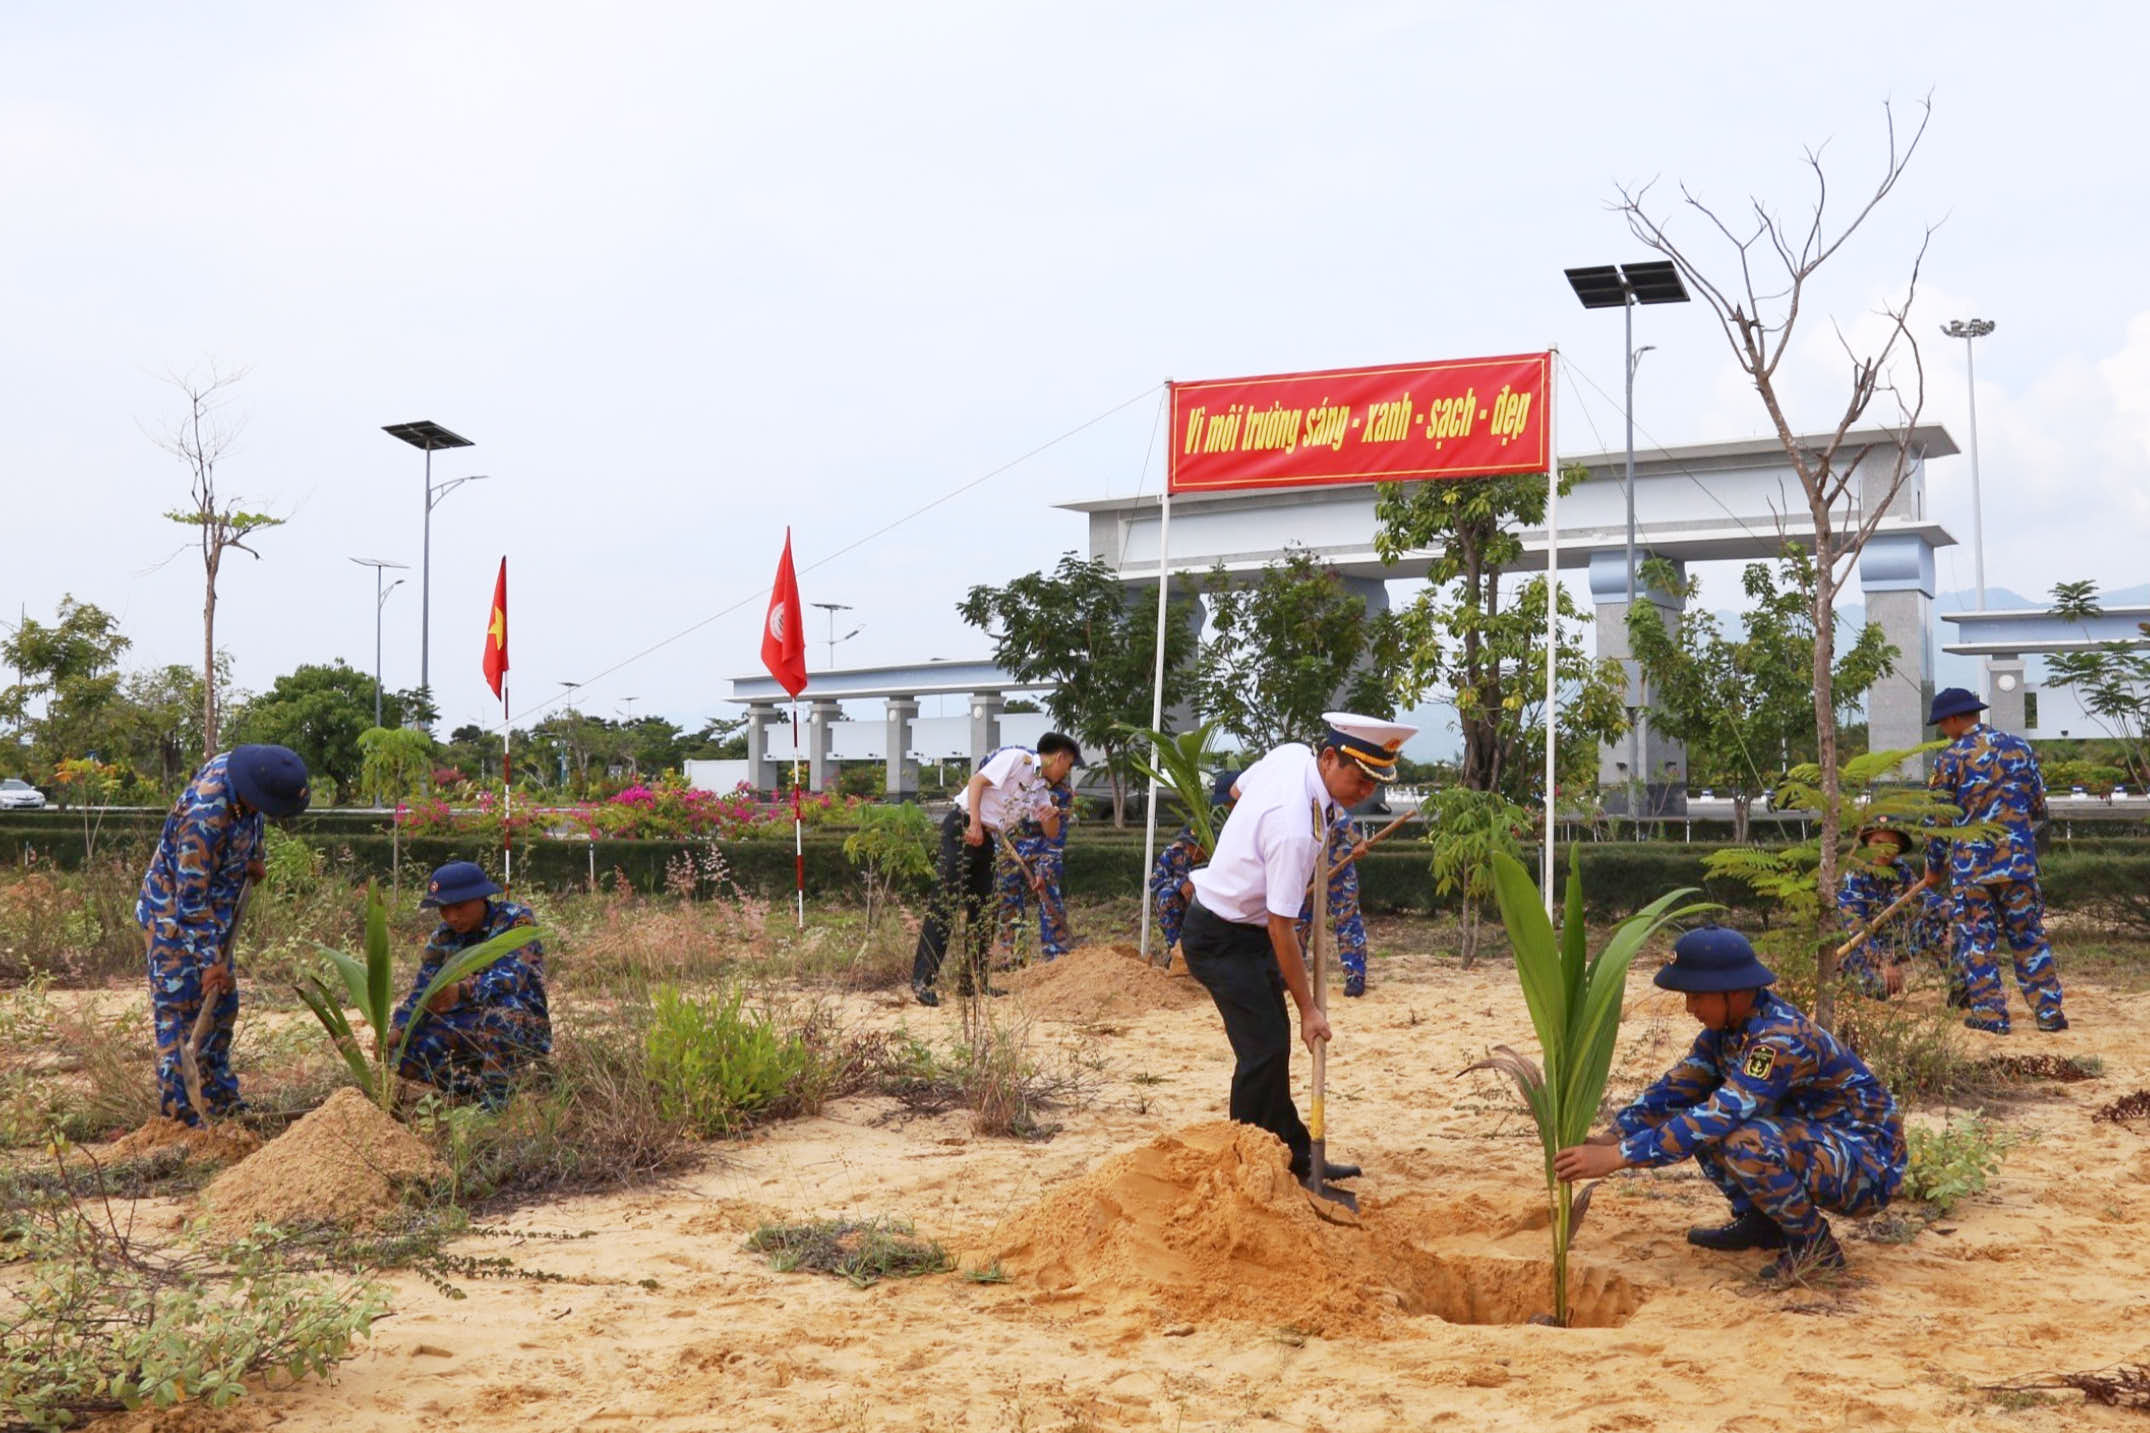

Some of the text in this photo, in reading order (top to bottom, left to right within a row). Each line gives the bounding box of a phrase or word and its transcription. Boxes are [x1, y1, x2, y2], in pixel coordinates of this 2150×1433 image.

[1184, 405, 1206, 455] Vì
[1203, 403, 1243, 454] môi
[1241, 400, 1303, 455] trường
[1302, 396, 1351, 452] sáng
[1361, 391, 1413, 443] xanh
[1425, 387, 1477, 450] sạch
[1490, 384, 1532, 446] đẹp
